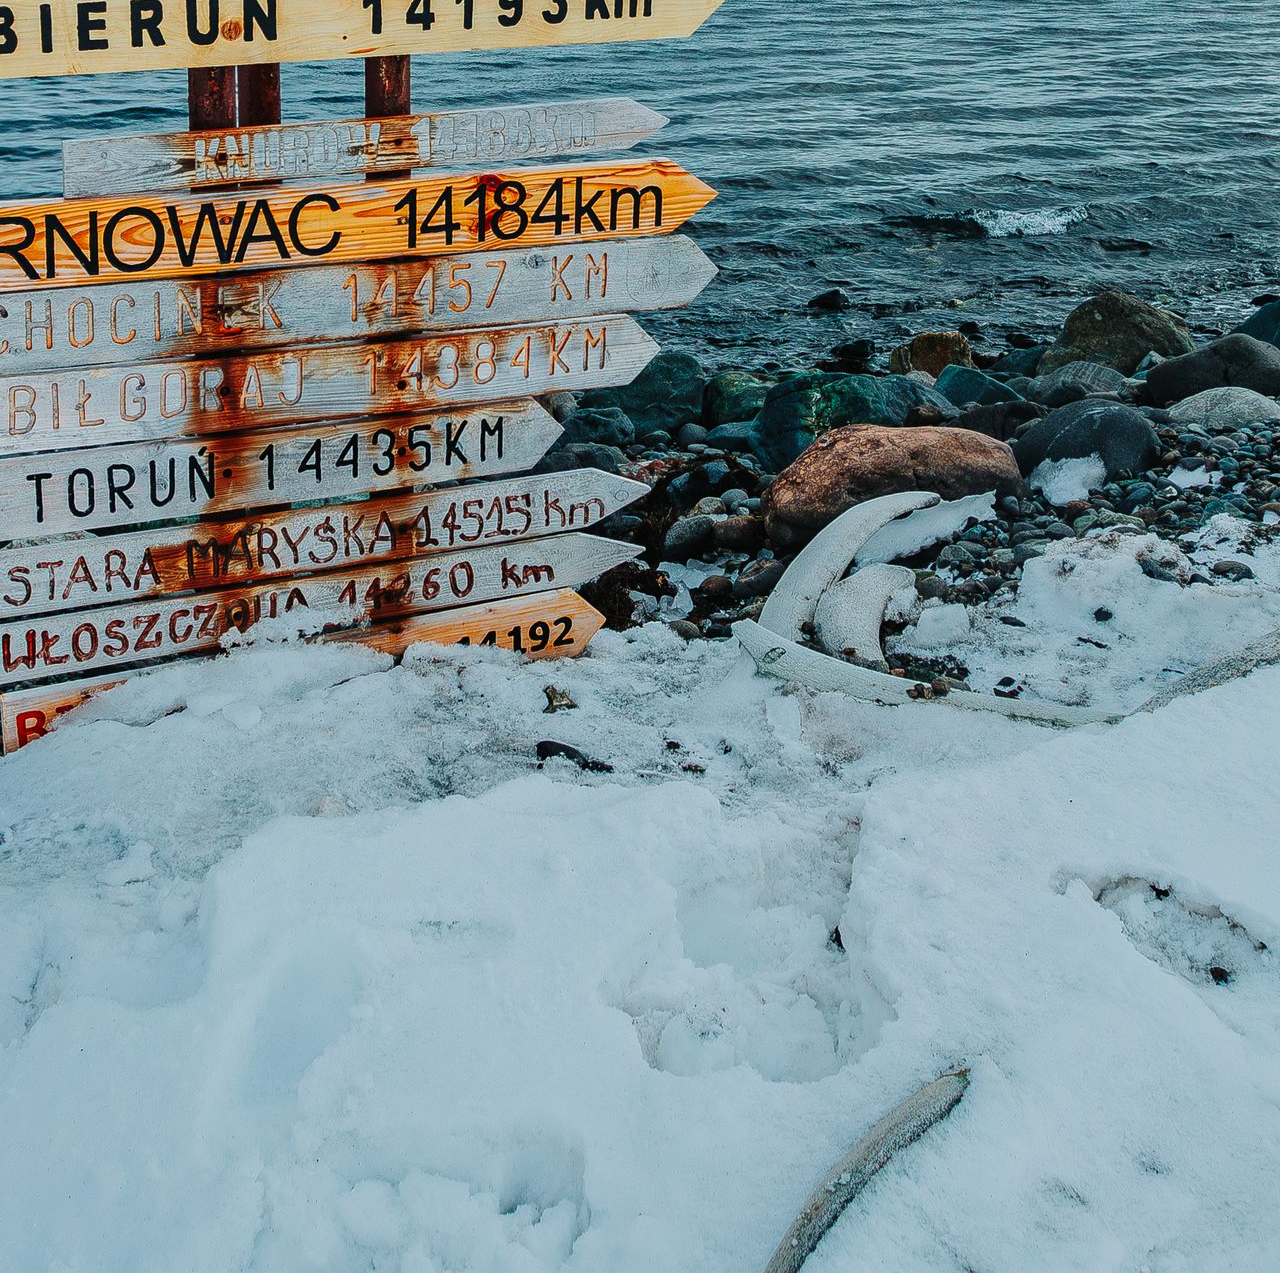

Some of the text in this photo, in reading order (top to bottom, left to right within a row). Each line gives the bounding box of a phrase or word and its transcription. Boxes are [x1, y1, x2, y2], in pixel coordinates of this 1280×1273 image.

[342, 261, 507, 324] 14457
[551, 252, 608, 302] KM
[9, 357, 303, 435] BIŁGORAJ
[26, 446, 216, 523] TORUŃ
[3, 490, 606, 606] STARA MARYŚKA 14515 km
[501, 556, 555, 589] km
